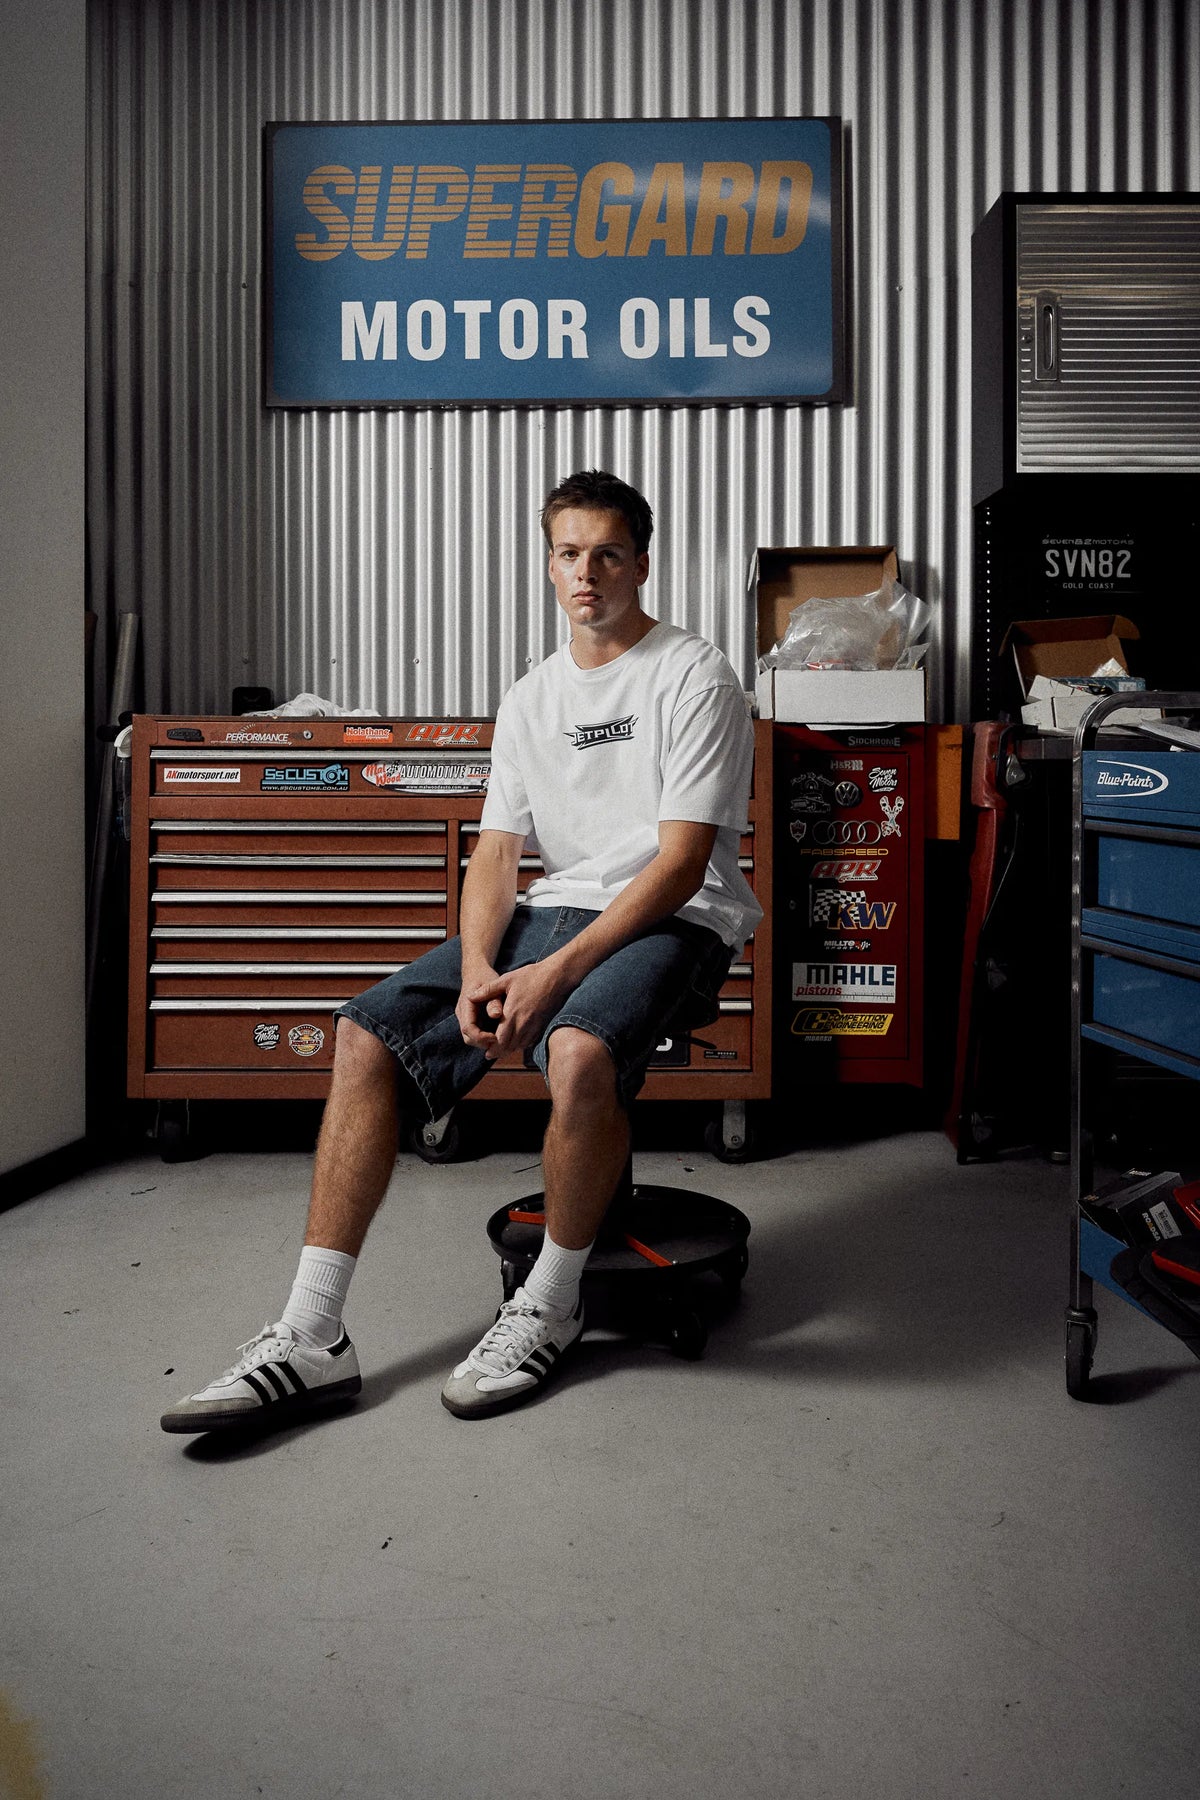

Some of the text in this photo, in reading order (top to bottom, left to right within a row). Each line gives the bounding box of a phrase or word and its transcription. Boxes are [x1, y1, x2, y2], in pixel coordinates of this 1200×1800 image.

[295, 160, 814, 261] SUPERGARD
[340, 296, 771, 361] MOTOR OILS
[1045, 549, 1132, 578] SVN82
[226, 733, 289, 742] PERFORMANCE
[406, 724, 481, 741] APR
[567, 718, 639, 748] JETPILOT
[848, 736, 900, 747] SIDCHROME
[166, 770, 239, 780] AKmotorsport.net
[400, 764, 467, 779] AUTOMOTIVE
[812, 860, 880, 878] APR
[828, 902, 897, 930] KW
[806, 965, 895, 986] MAHLE
[796, 986, 842, 997] pistons
[824, 1021, 884, 1029] ENGINEERING
